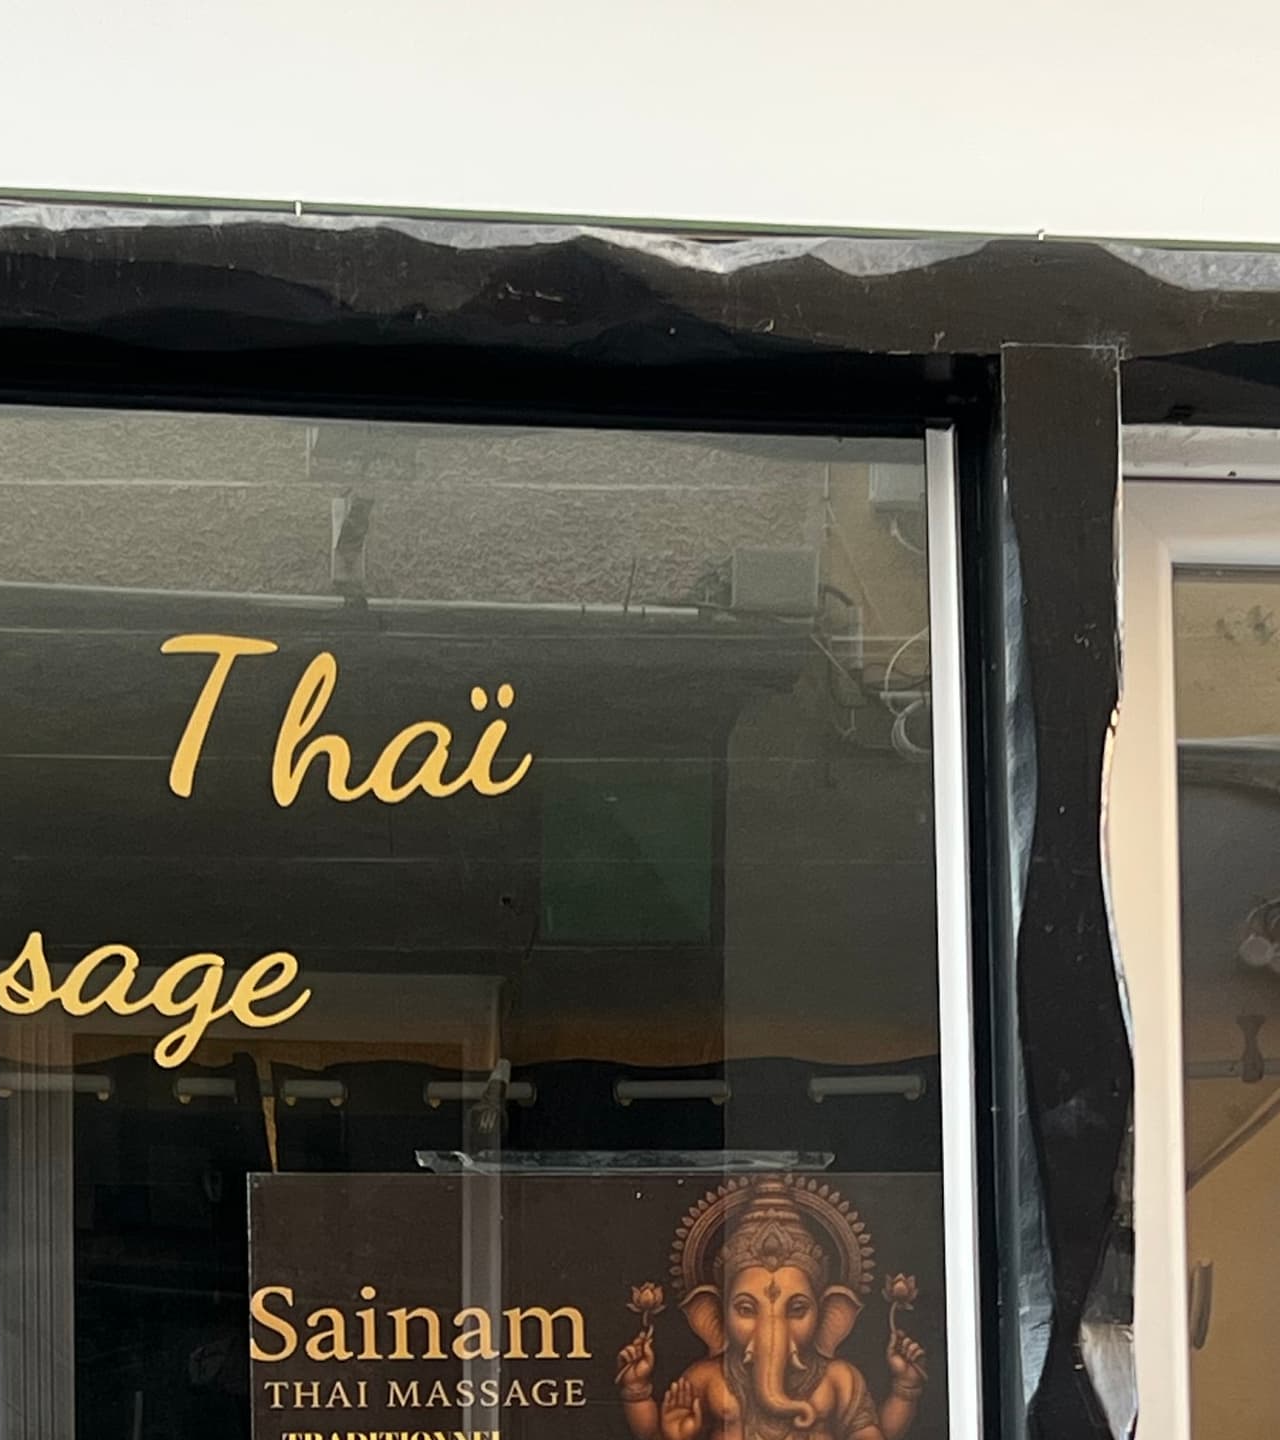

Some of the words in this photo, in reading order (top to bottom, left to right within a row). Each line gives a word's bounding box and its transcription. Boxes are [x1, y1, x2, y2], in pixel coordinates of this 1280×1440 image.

[160, 634, 532, 807] Thaï
[249, 1285, 592, 1362] Sainam
[264, 1381, 369, 1409] THAI
[386, 1379, 587, 1408] MASSAGE
